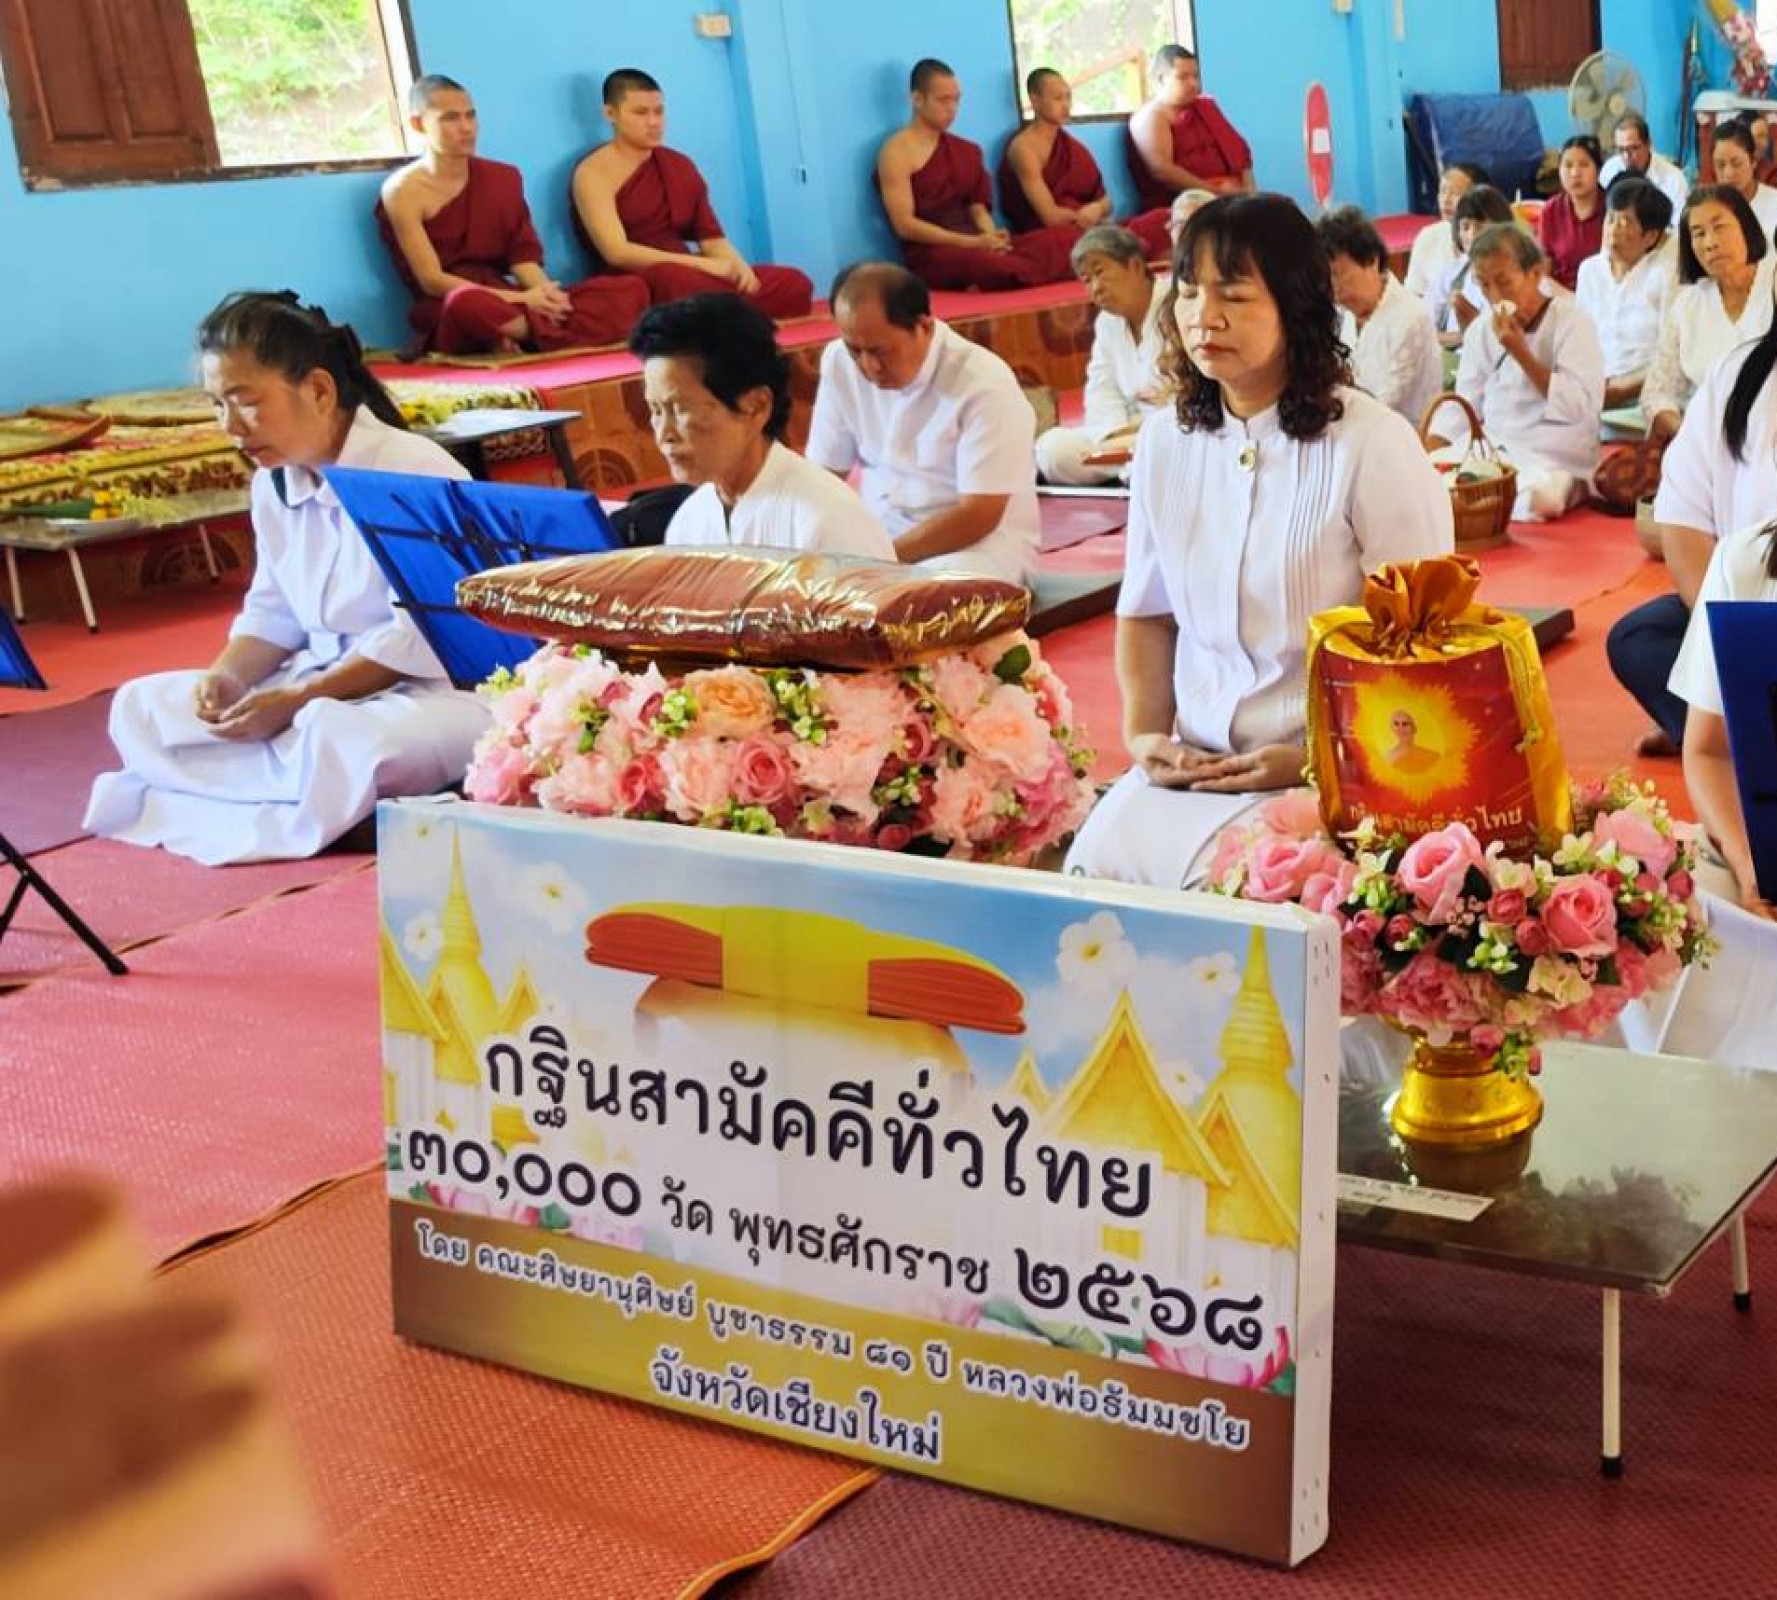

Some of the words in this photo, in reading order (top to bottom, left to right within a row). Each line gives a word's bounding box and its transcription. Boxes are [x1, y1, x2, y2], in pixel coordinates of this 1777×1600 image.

[486, 1025, 1152, 1217] กฐินสามัคคีทั่วไทย
[409, 1129, 641, 1216] ๓๐,๐๐๐
[662, 1176, 713, 1235] วัด
[729, 1207, 989, 1294] พุทธศักราช
[1016, 1249, 1263, 1351] ๒๕๖๘
[418, 1223, 467, 1261] โดย
[479, 1246, 693, 1317] คณะศิษยานุศิษย์
[707, 1302, 851, 1356] บูชาธรรม
[926, 1343, 947, 1378] ปี
[653, 1350, 940, 1460] จังหวัดเชียงใหม่
